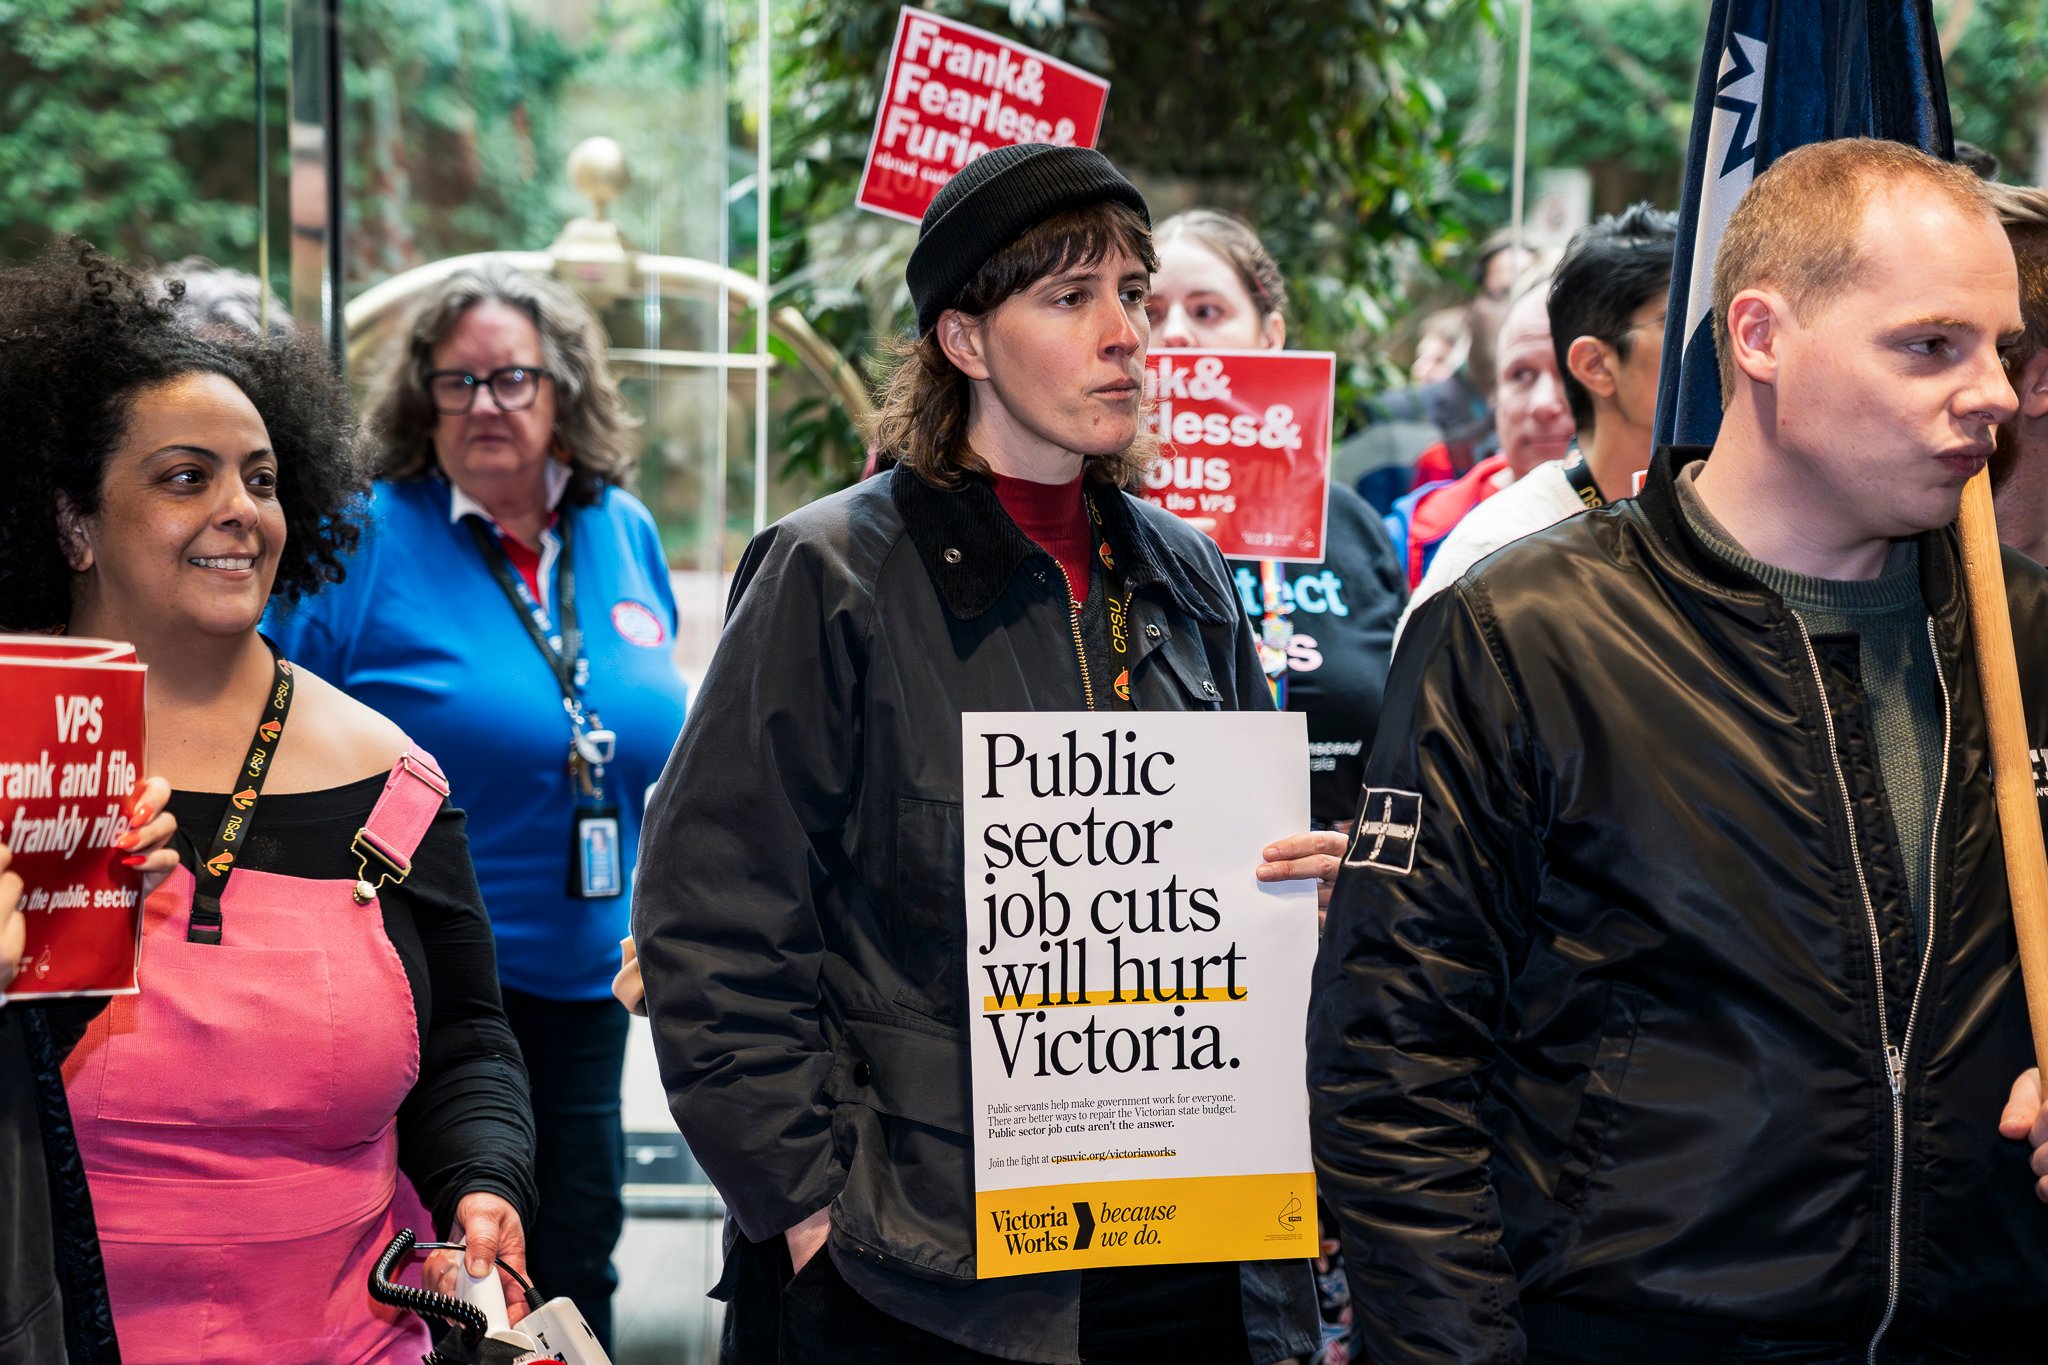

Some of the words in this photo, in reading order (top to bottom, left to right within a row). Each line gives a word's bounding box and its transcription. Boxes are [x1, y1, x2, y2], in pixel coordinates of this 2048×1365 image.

[902, 18, 1045, 106] Frank&
[893, 61, 1076, 146] Fearless&
[1165, 493, 1195, 511] the
[1199, 494, 1236, 513] VPS
[1108, 597, 1127, 653] CPSU
[274, 680, 290, 710] CPSU
[55, 694, 104, 744] VPS
[59, 750, 103, 798] and
[106, 749, 136, 797] file
[248, 748, 267, 778] CPSU
[980, 729, 1176, 799] Public
[8, 804, 89, 860] frankly
[87, 803, 132, 848] rile
[223, 815, 243, 842] CPSU
[983, 807, 1173, 869] sector
[27, 886, 49, 910] the
[48, 883, 90, 913] public
[93, 885, 138, 908] sector
[979, 869, 1071, 955] job
[1090, 874, 1221, 934] cuts
[983, 937, 1091, 1008] will
[1107, 935, 1248, 1004] hurt
[983, 1004, 1240, 1079] Victoria.
[987, 1103, 1012, 1114] Public
[1014, 1102, 1049, 1112] servants
[1051, 1099, 1069, 1111] help
[1071, 1098, 1095, 1108] make
[1097, 1096, 1150, 1109] government
[1152, 1094, 1175, 1104] work
[1177, 1093, 1190, 1104] for
[1192, 1094, 1236, 1104] everyone.
[987, 1116, 1012, 1127] There
[1013, 1116, 1027, 1125] are
[1028, 1113, 1053, 1124] better
[1055, 1113, 1077, 1122] ways
[1078, 1111, 1087, 1120] to
[1089, 1109, 1116, 1121] repair
[1118, 1108, 1133, 1118] the
[1135, 1106, 1176, 1117] Victorian
[1178, 1106, 1200, 1115] state
[1202, 1104, 1236, 1115] budget.
[988, 1126, 1016, 1139] Public
[1018, 1126, 1046, 1137] sector
[1048, 1124, 1063, 1136] job
[1065, 1124, 1085, 1133] cuts
[1088, 1121, 1116, 1132] aren't
[1119, 1120, 1134, 1130] the
[1137, 1120, 1175, 1129] answer.
[988, 1158, 1005, 1170] Join
[1006, 1156, 1019, 1167] the
[1021, 1154, 1040, 1167] fight
[1041, 1155, 1050, 1164] at
[1051, 1147, 1176, 1164] cpsuvic.org/victoriaworks
[991, 1205, 1068, 1233] Victoria
[1100, 1202, 1177, 1224] because
[1004, 1230, 1068, 1256] Works
[1101, 1231, 1128, 1247] we
[1134, 1224, 1161, 1245] do.
